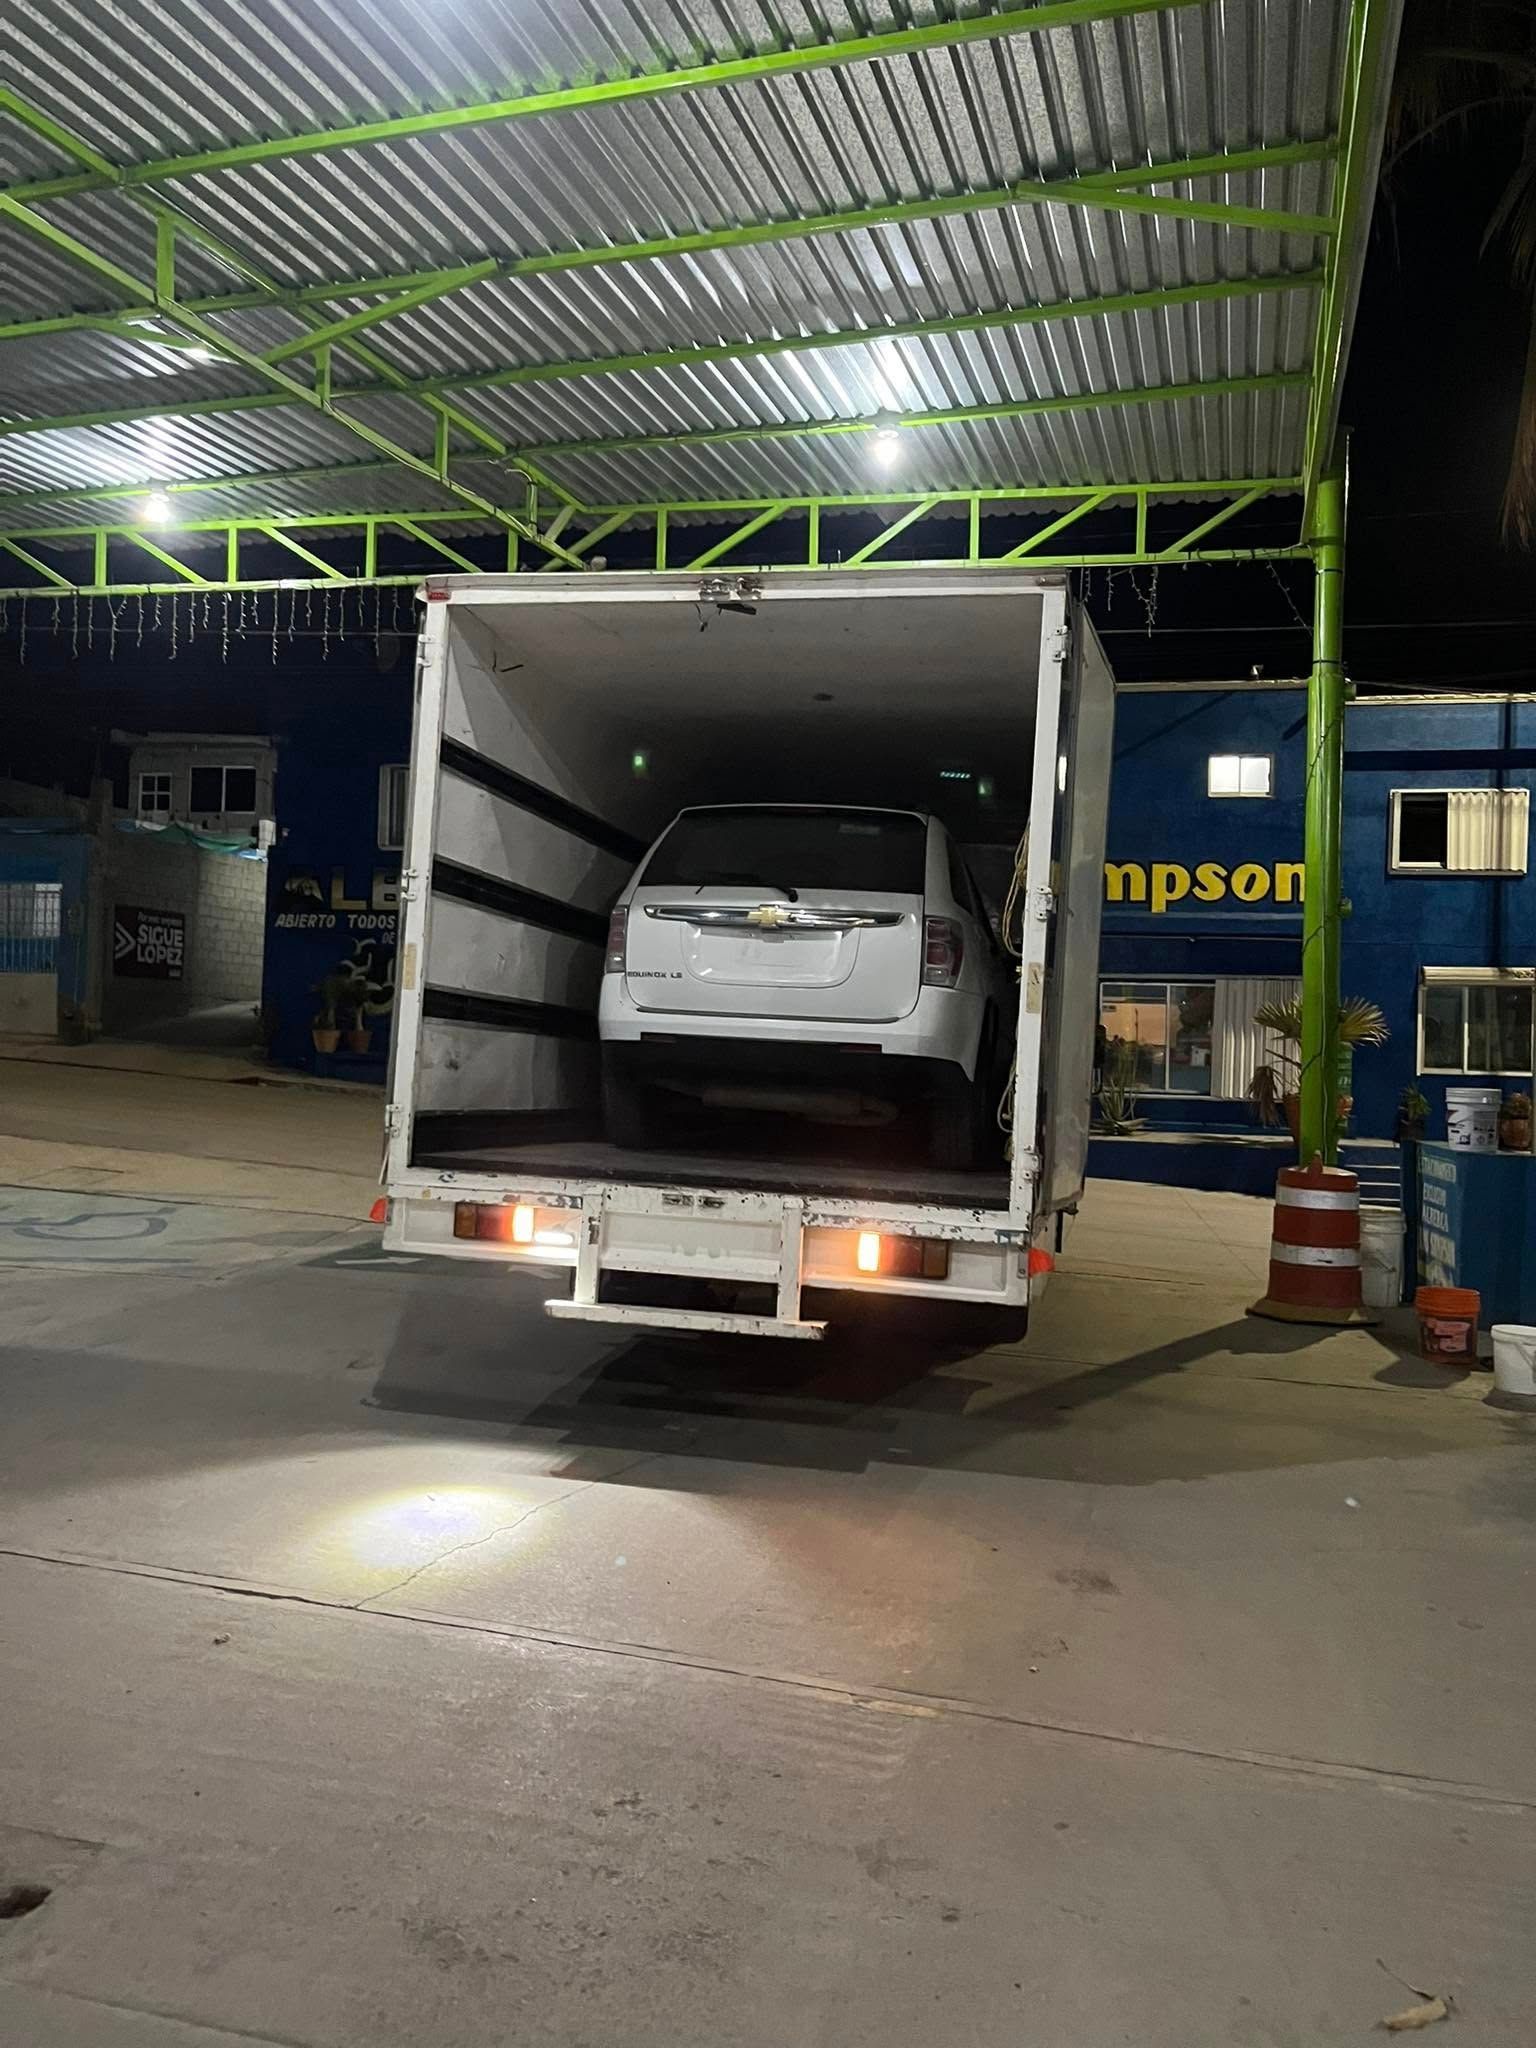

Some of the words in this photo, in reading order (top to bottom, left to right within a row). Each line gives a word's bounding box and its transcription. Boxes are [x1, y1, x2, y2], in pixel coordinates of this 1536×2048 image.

[274, 913, 337, 929] ABIERTO
[347, 914, 397, 929] TODOS
[137, 924, 184, 948] SIGUE
[627, 970, 667, 979] EQUINOX
